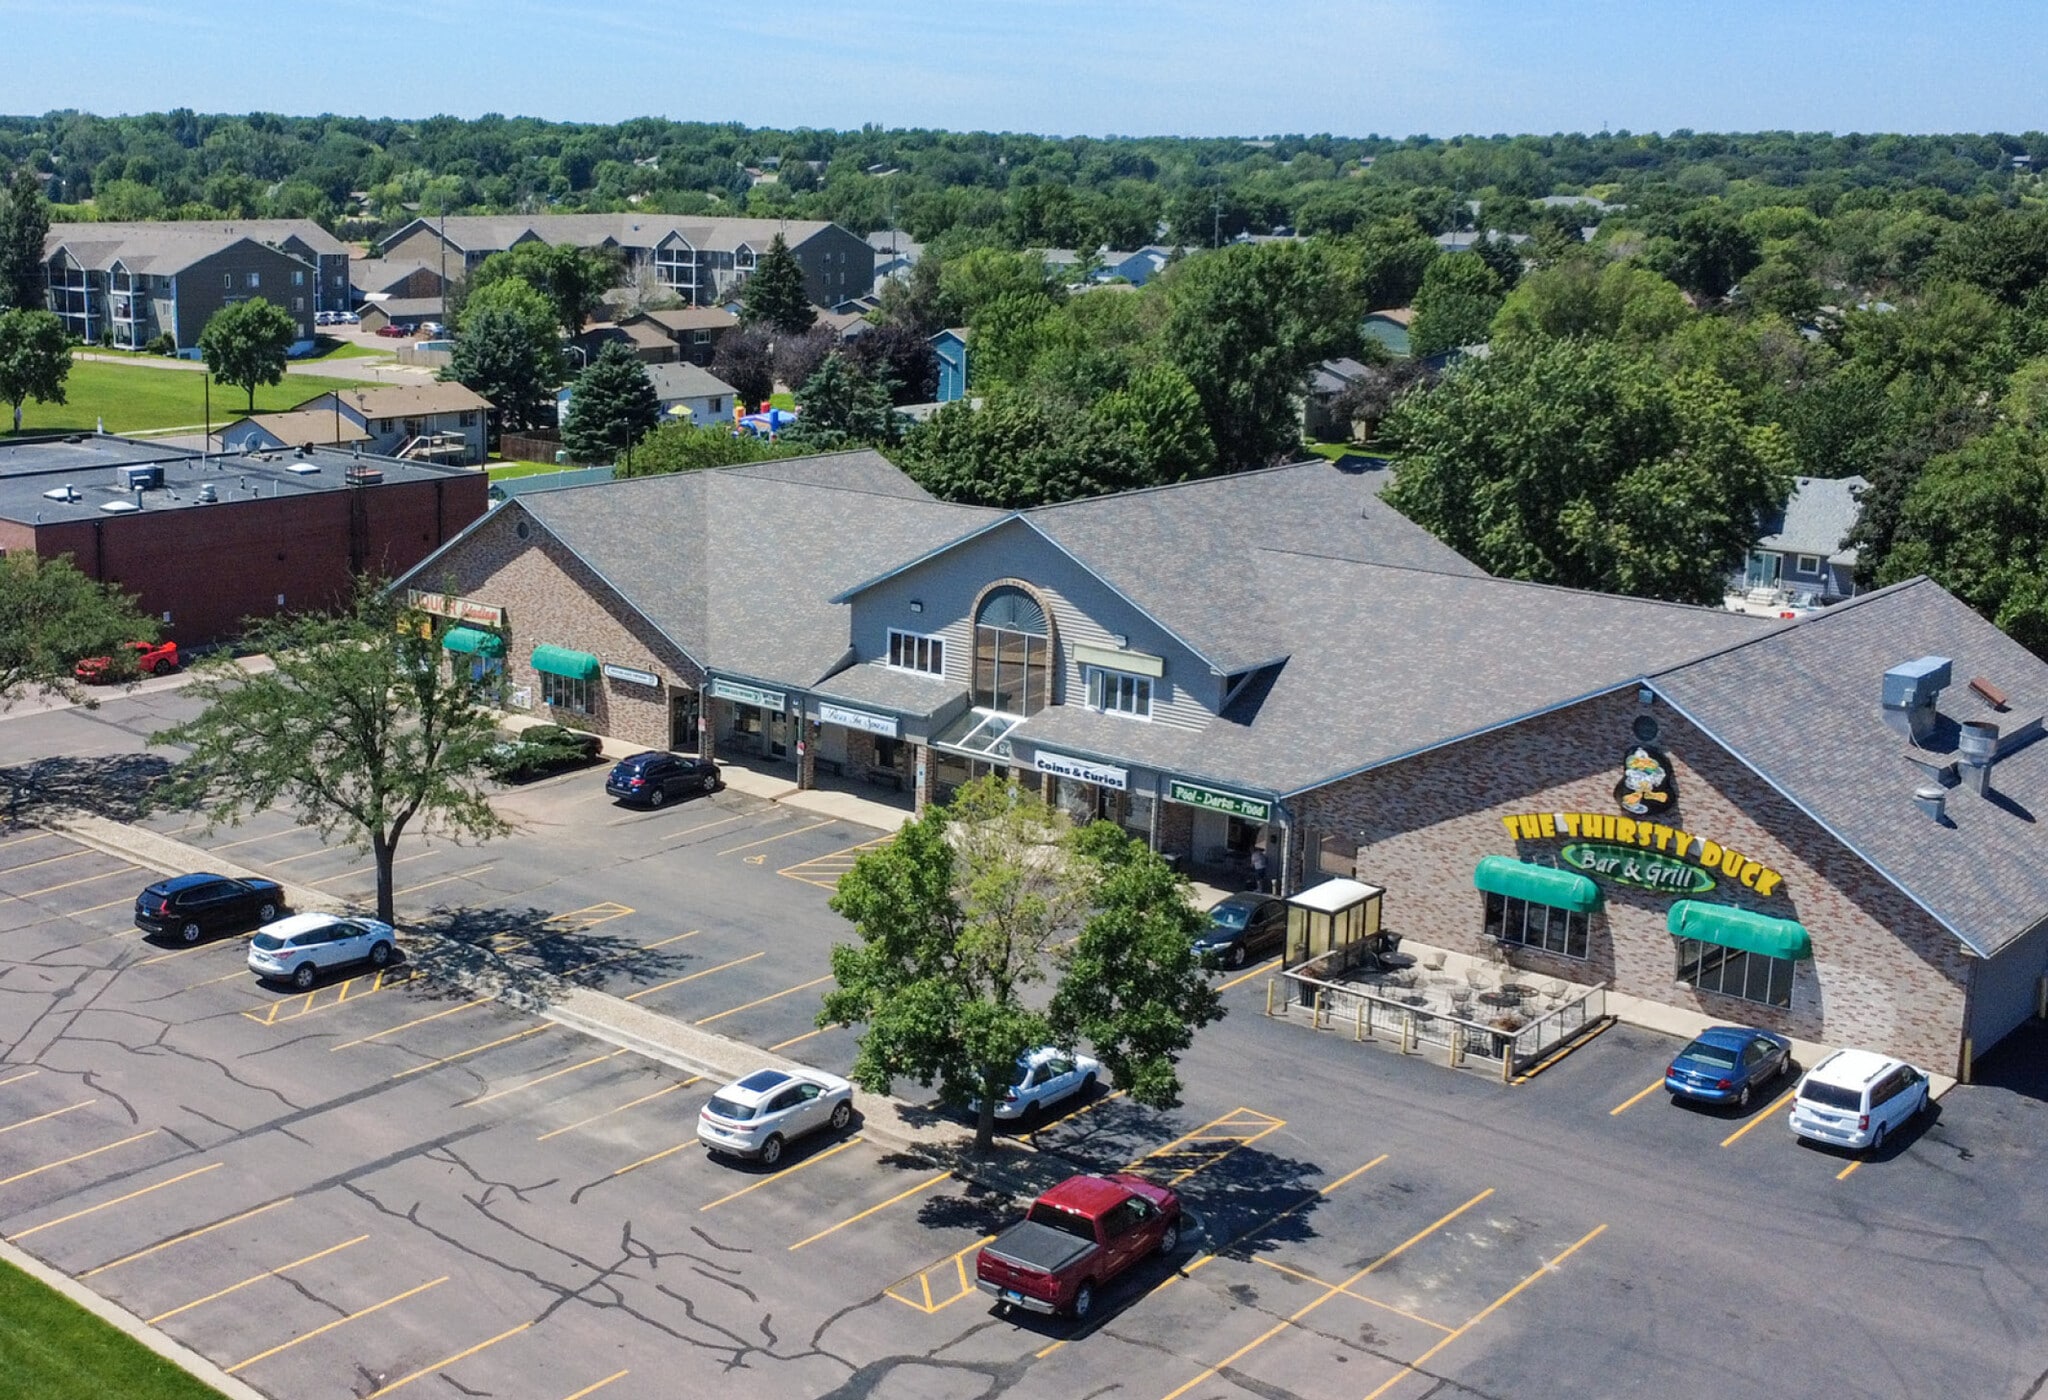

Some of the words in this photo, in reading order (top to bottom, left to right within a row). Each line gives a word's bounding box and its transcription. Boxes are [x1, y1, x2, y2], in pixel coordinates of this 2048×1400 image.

[1037, 759, 1071, 775] Coins
[1072, 767, 1081, 777] &
[1082, 770, 1123, 787] Curios
[1175, 787, 1197, 802] Pool
[1203, 793, 1235, 810] Darts
[1241, 801, 1265, 817] Food
[1502, 813, 1556, 840] THE
[1563, 813, 1697, 857] THIRSTY
[1700, 838, 1783, 896] DUCK
[1580, 850, 1618, 874] Bar
[1623, 859, 1642, 881] &
[1646, 861, 1693, 887] Grill
